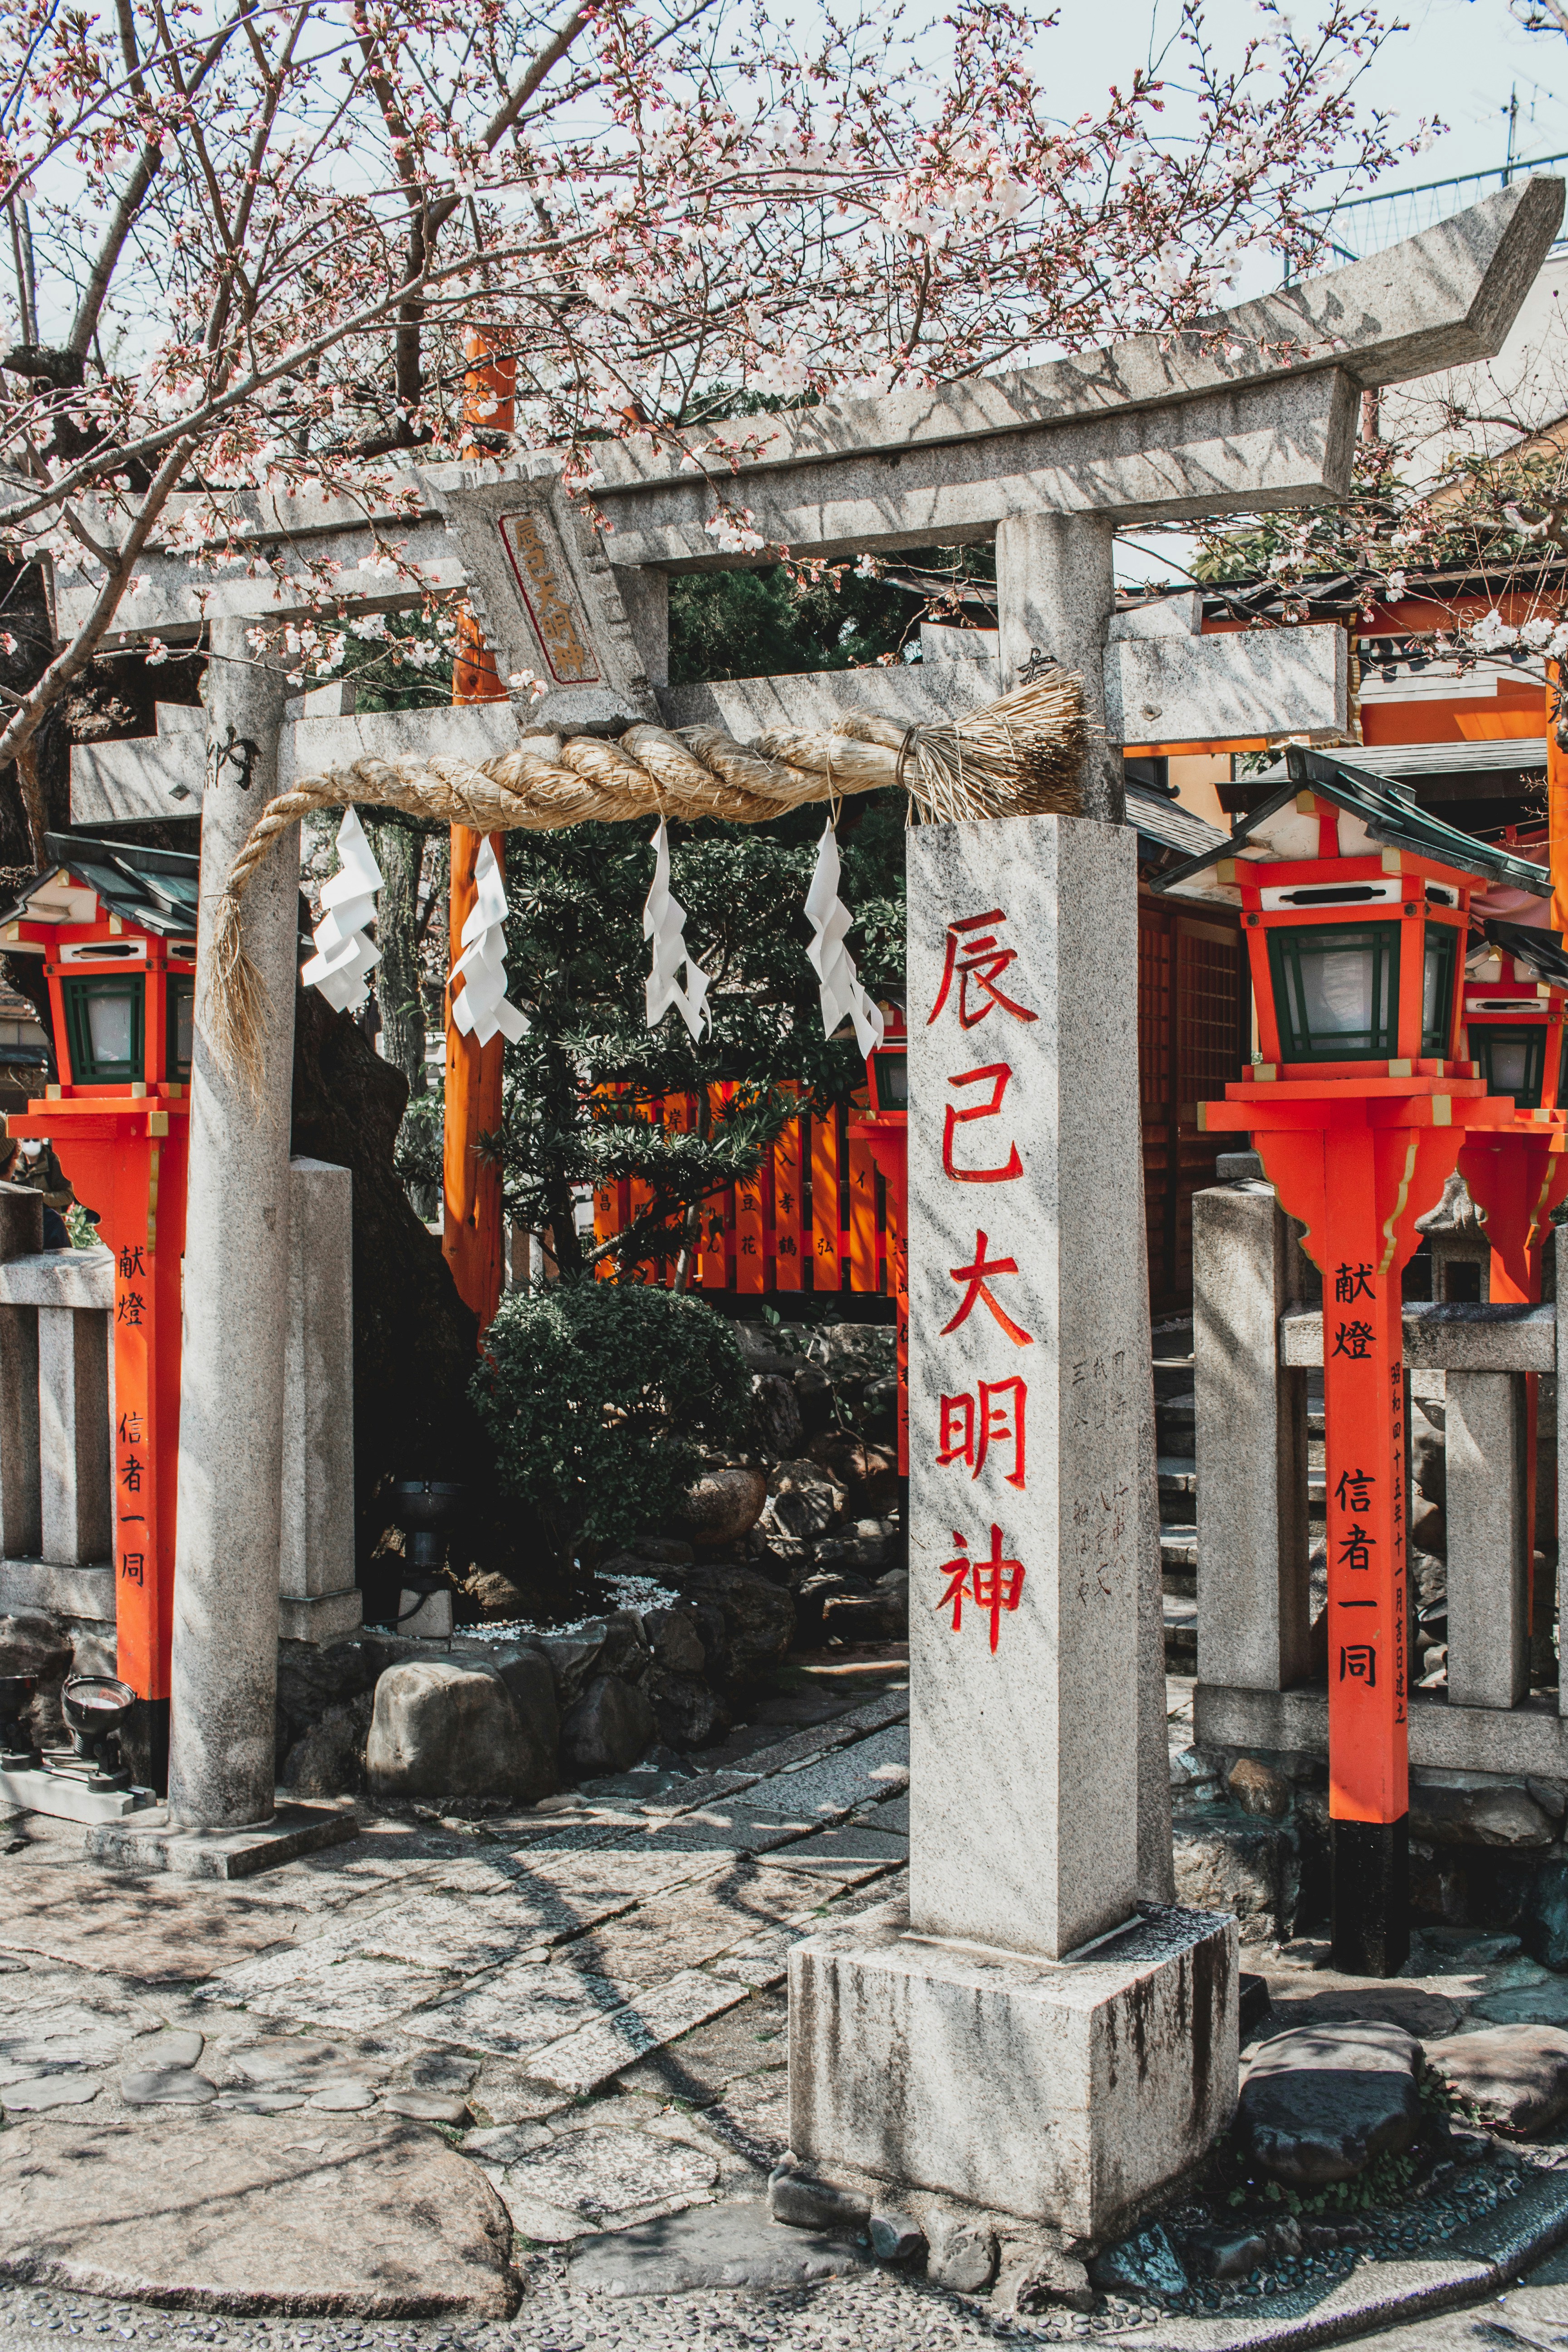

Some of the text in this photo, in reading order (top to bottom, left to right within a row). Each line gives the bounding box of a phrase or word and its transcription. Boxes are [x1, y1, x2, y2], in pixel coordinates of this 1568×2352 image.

[119, 1411, 145, 1587] 信者一同
[1335, 1469, 1377, 1687] 信者一同
